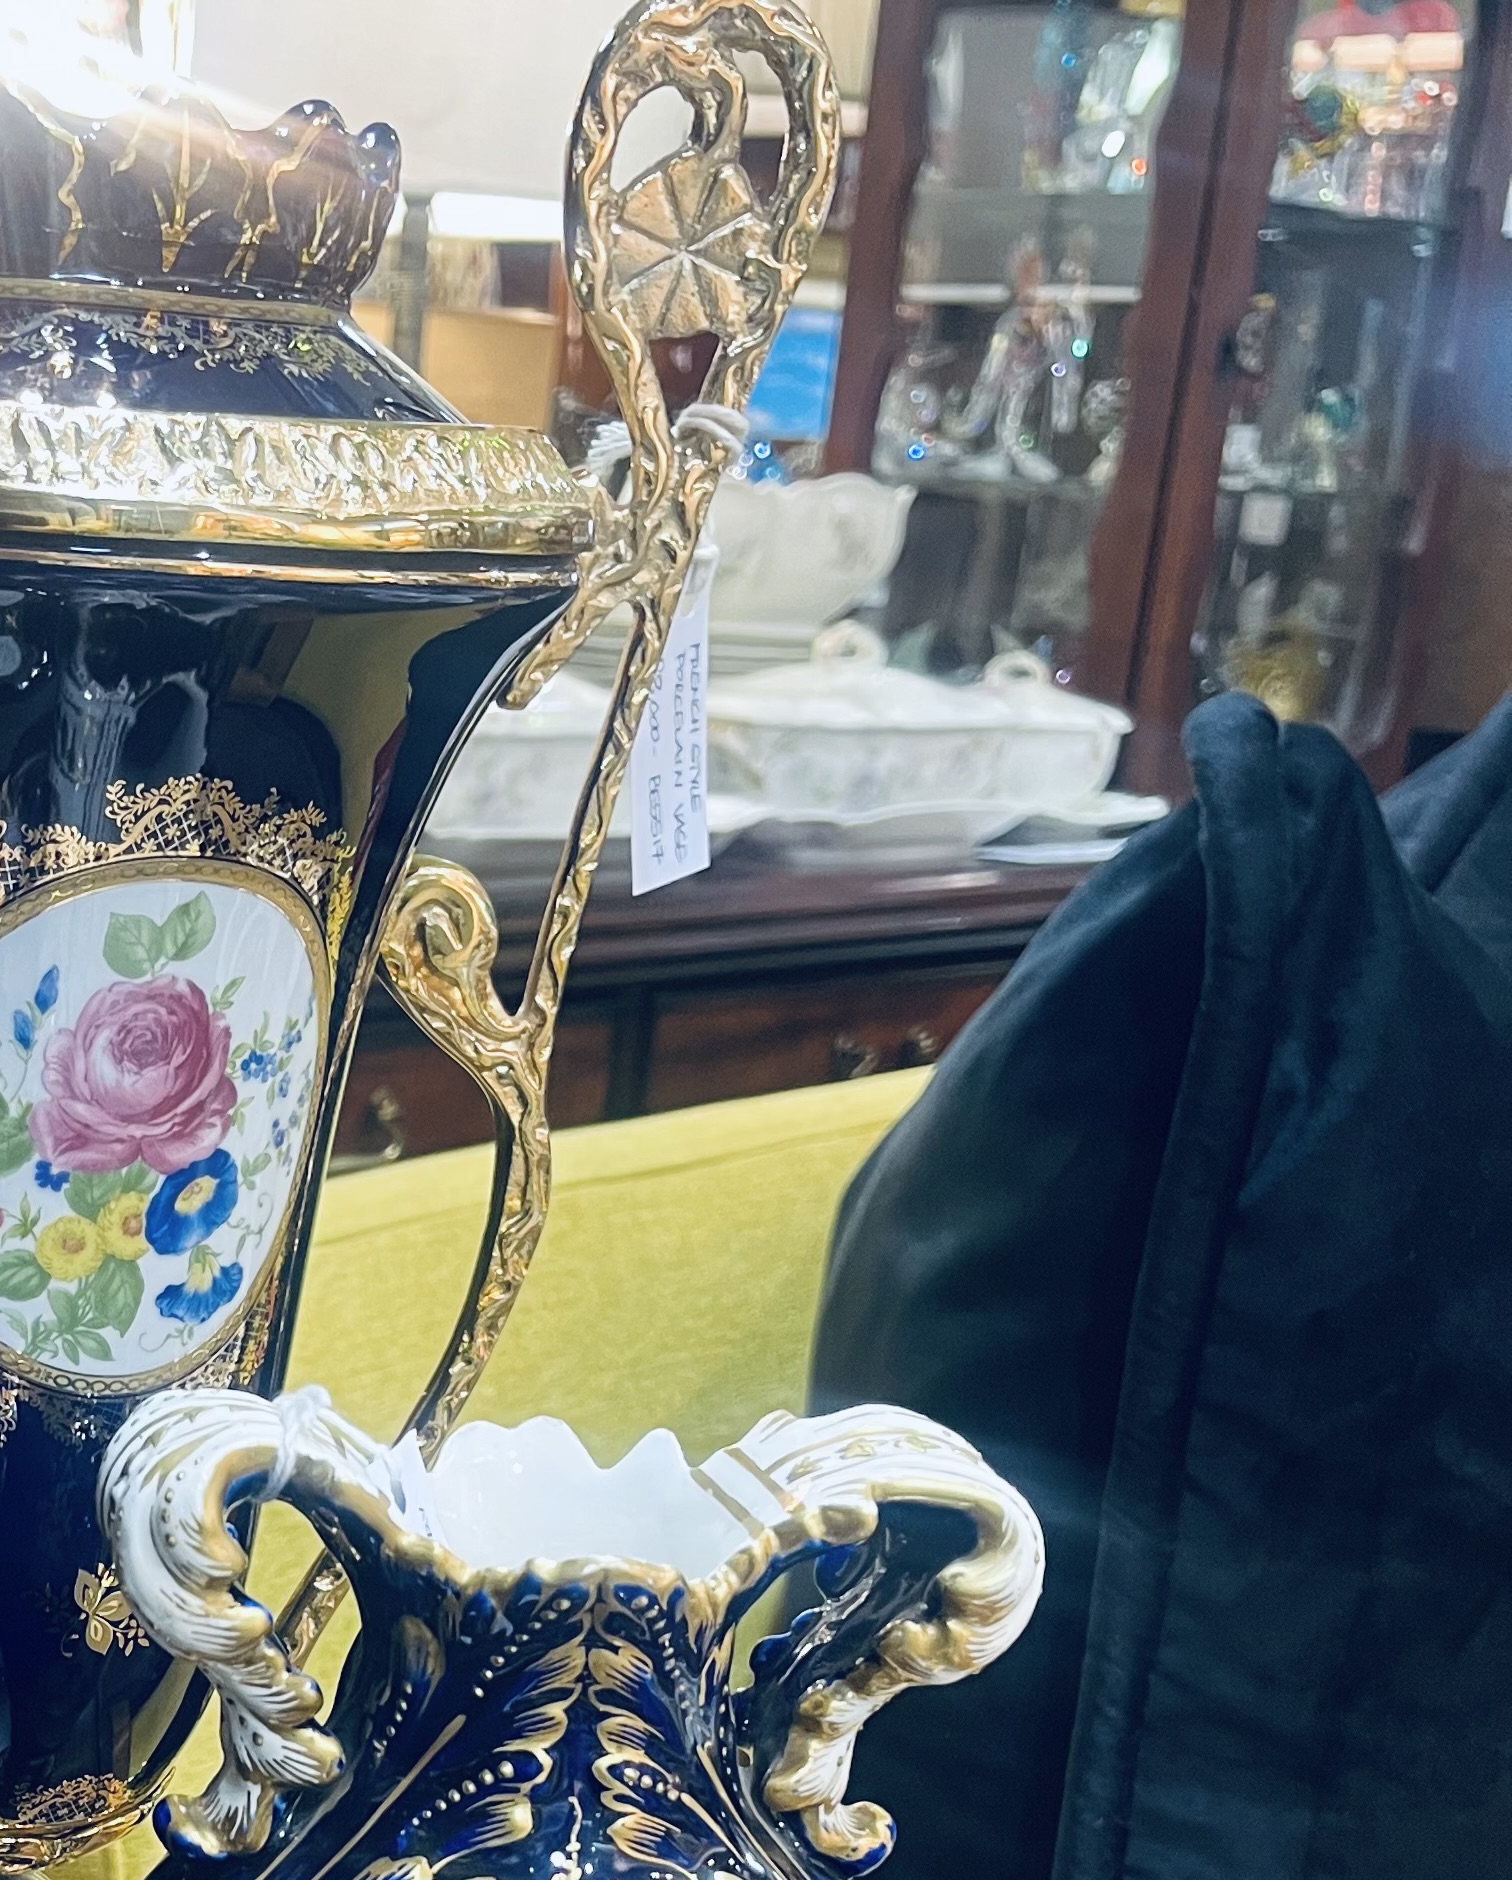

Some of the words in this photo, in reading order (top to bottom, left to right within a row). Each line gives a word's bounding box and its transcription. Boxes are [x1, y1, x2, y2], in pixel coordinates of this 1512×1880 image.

[674, 652, 686, 789] PORCELAIN
[690, 643, 701, 734] FRENCH
[690, 744, 702, 813] STYLE
[673, 803, 687, 865] VASE
